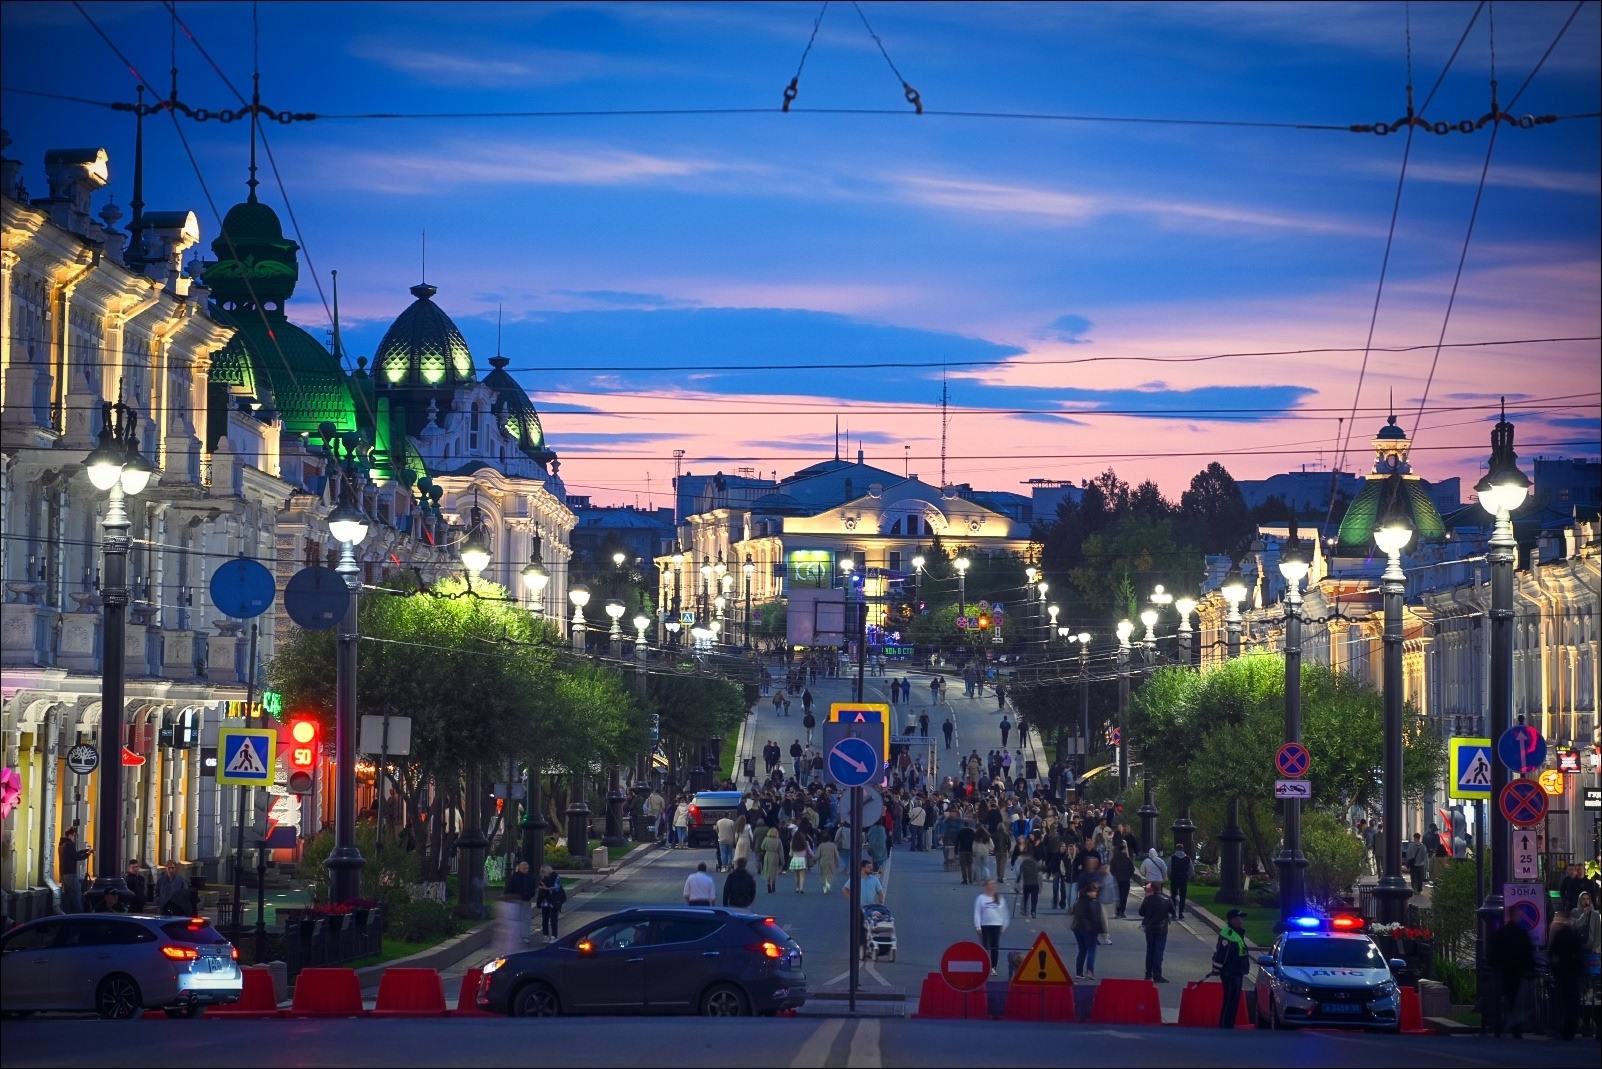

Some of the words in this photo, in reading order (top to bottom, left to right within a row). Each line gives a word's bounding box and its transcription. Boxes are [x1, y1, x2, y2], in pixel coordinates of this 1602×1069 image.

[294, 748, 312, 765] 50
[1519, 854, 1532, 864] 25
[1522, 866, 1531, 874] М
[1510, 888, 1537, 896] ЗОНА
[1311, 969, 1365, 977] ДПС
